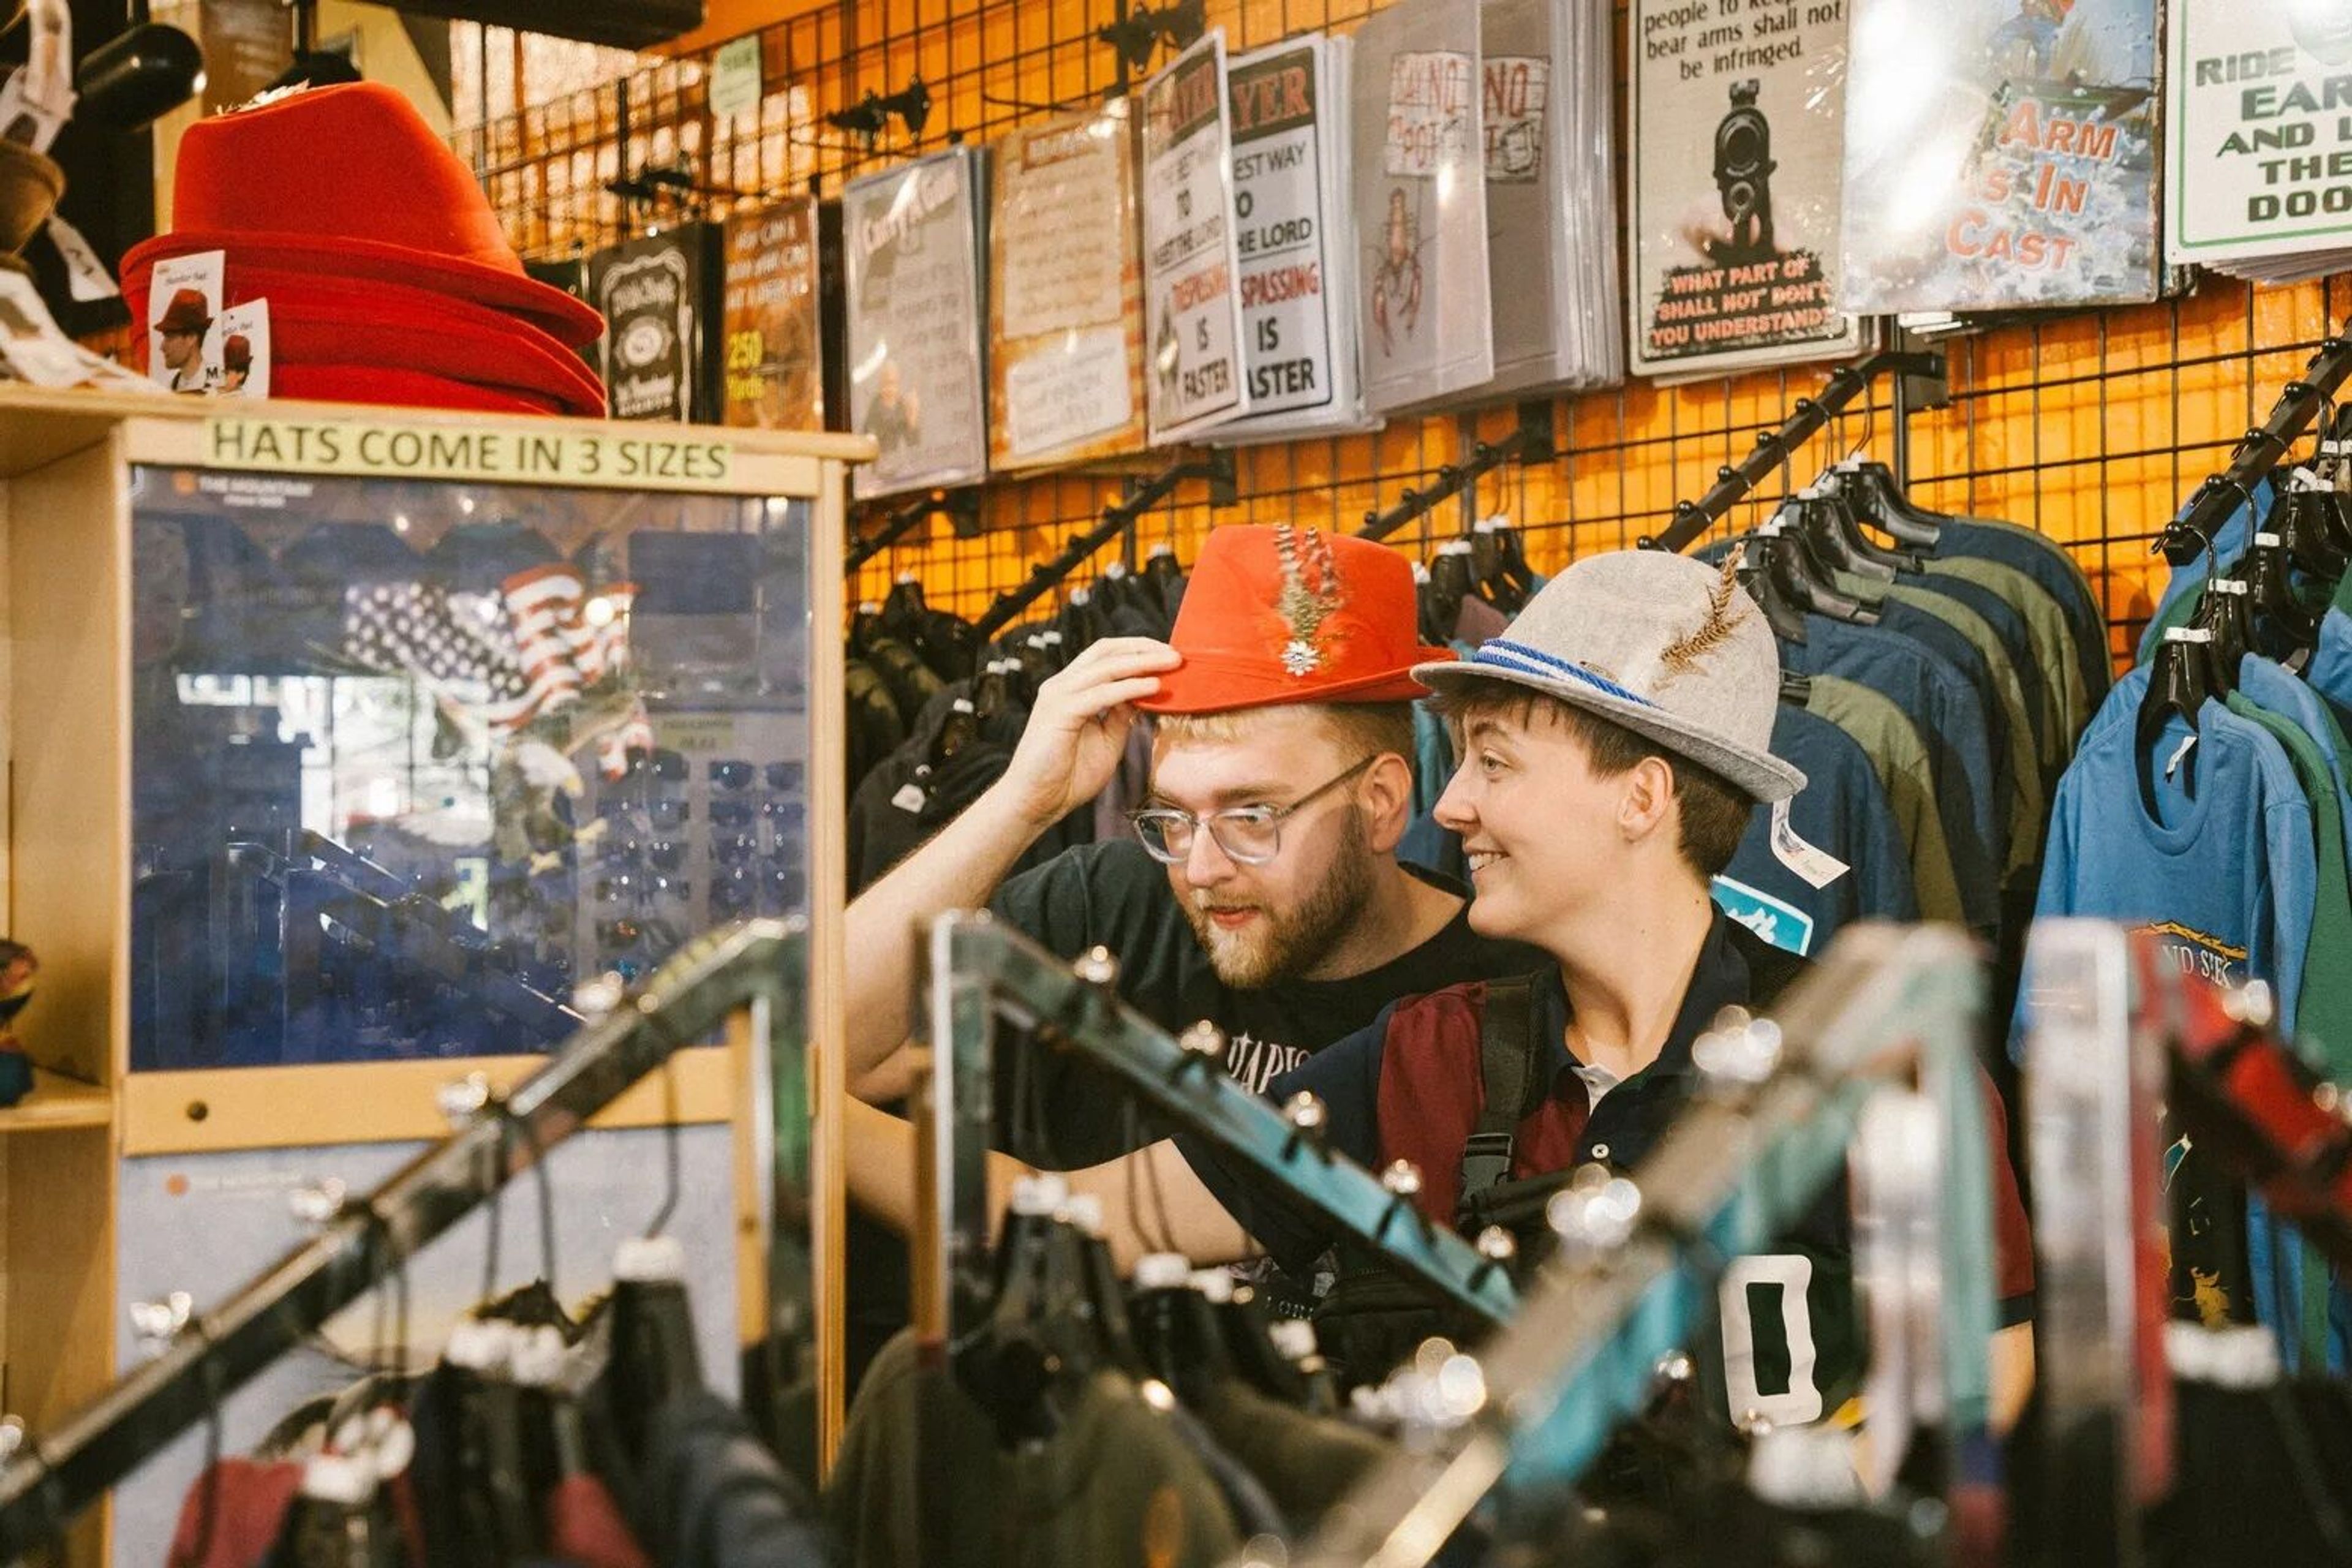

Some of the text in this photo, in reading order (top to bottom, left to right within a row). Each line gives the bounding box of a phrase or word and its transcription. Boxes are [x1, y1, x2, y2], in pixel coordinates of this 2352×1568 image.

[1644, 0, 1738, 37] people to
[1646, 1, 1842, 59] bear arms shall not
[1680, 59, 1703, 80] be
[2196, 47, 2296, 87] RIDE
[1230, 66, 1311, 132] YER
[1484, 62, 1528, 120] NO
[2242, 74, 2352, 121] EAR
[2215, 122, 2315, 157] AND
[1233, 154, 1266, 182] EST
[1267, 141, 1306, 172] WAY
[2248, 186, 2352, 222] DOO
[1237, 218, 1312, 253] HE LORD
[1242, 262, 1319, 309] SPASSING
[1671, 256, 1810, 293] WHAT PART OF
[1197, 314, 1209, 351] IS
[1258, 316, 1279, 352] IS
[1652, 325, 1689, 346] YOU
[206, 366, 219, 380] M
[1184, 357, 1230, 403] FASTER
[1247, 358, 1316, 401] ASTER
[213, 423, 726, 479] HATS COME IN 3 SIZES
